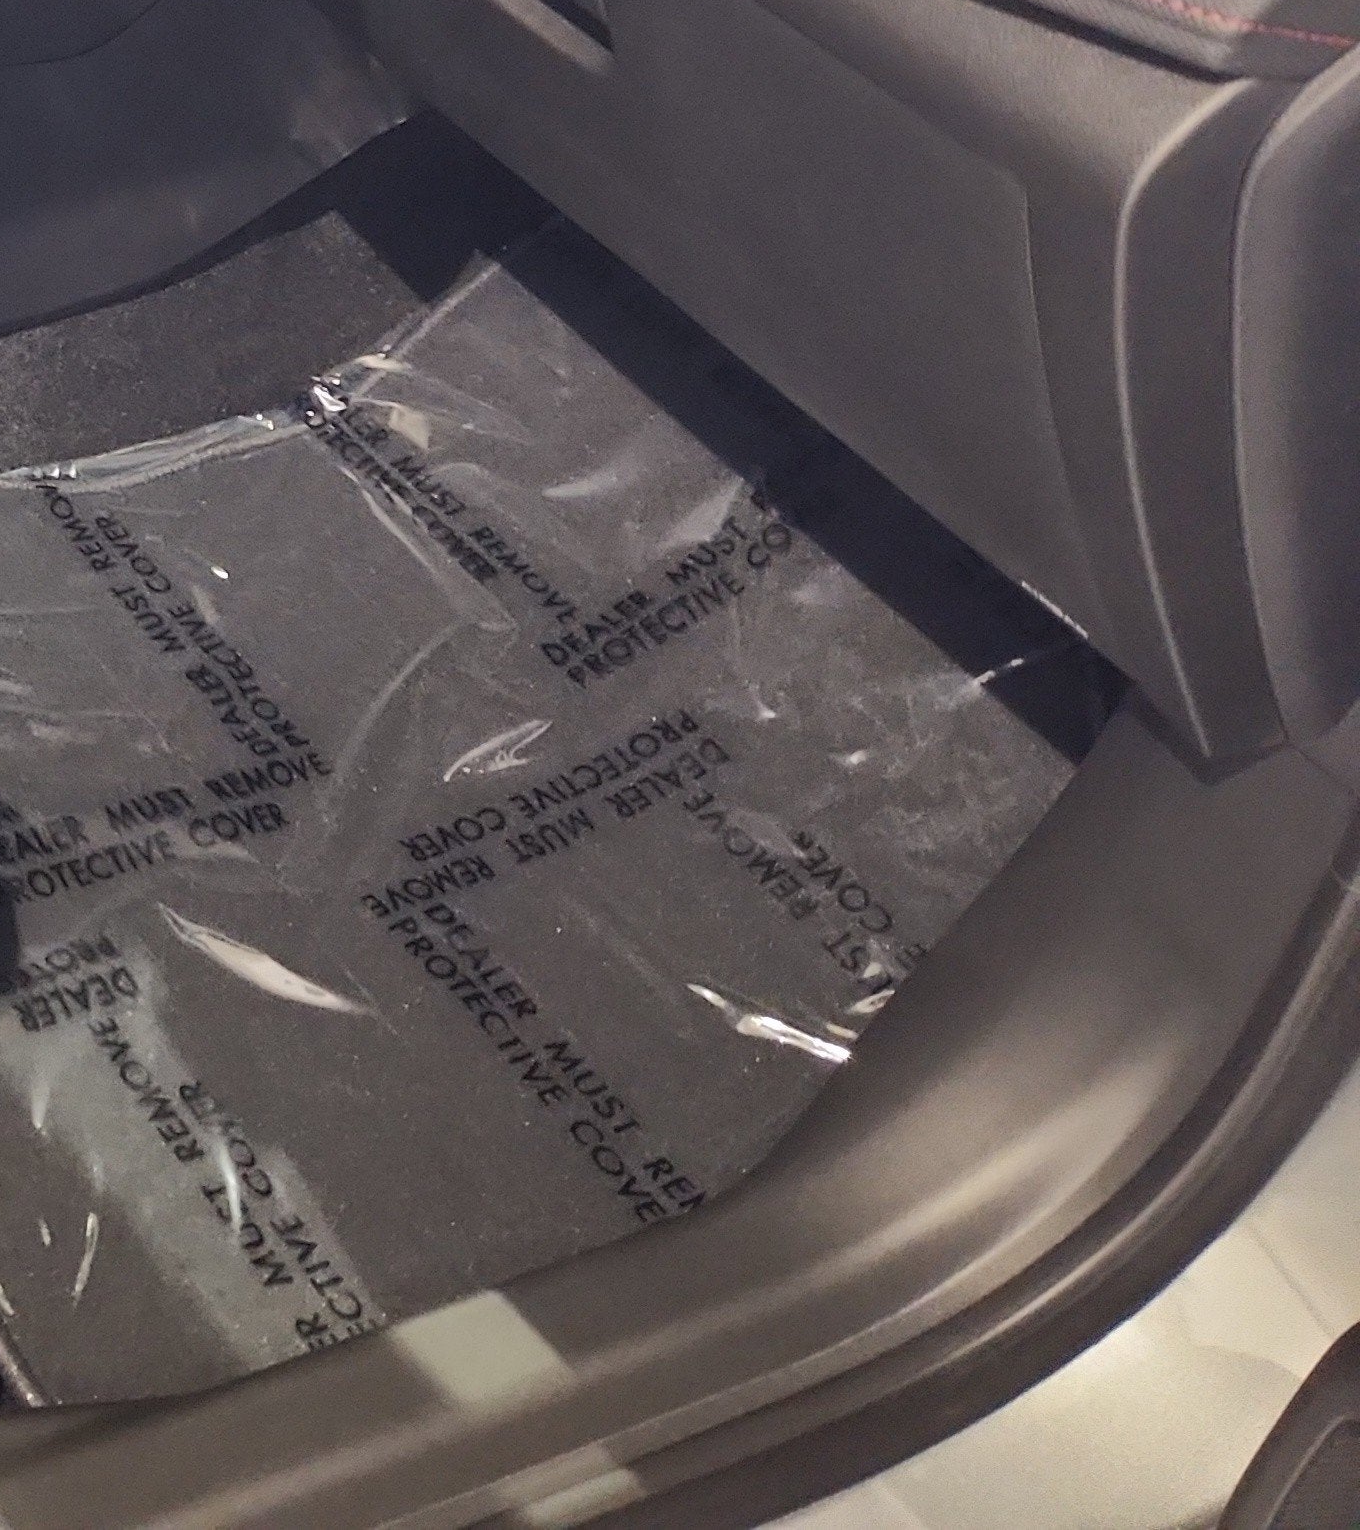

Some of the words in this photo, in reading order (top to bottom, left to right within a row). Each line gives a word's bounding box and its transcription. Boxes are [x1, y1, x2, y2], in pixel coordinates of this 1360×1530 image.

[95, 512, 173, 592] COVER
[391, 454, 467, 517] MUST
[468, 525, 579, 627] REMOVE
[109, 583, 184, 656] MUST
[540, 588, 651, 668] DEALER
[664, 515, 750, 586] MUST
[569, 570, 745, 688] PROTECTIVE
[182, 663, 280, 758] DEALER
[104, 786, 195, 834] MUST
[203, 751, 333, 803] REMOVE
[507, 708, 698, 815] PROTECTIVE
[611, 738, 731, 821] DEALER
[187, 801, 292, 848] COVER
[398, 803, 508, 863] COVER
[506, 806, 595, 864] MUST
[360, 856, 497, 924] REMOVE
[11, 964, 140, 1033] DEALER
[388, 916, 570, 1107] PROTECTIVE
[423, 897, 539, 1018] DEALER
[541, 1037, 643, 1137] MUST
[88, 1016, 204, 1164] REMOVE
